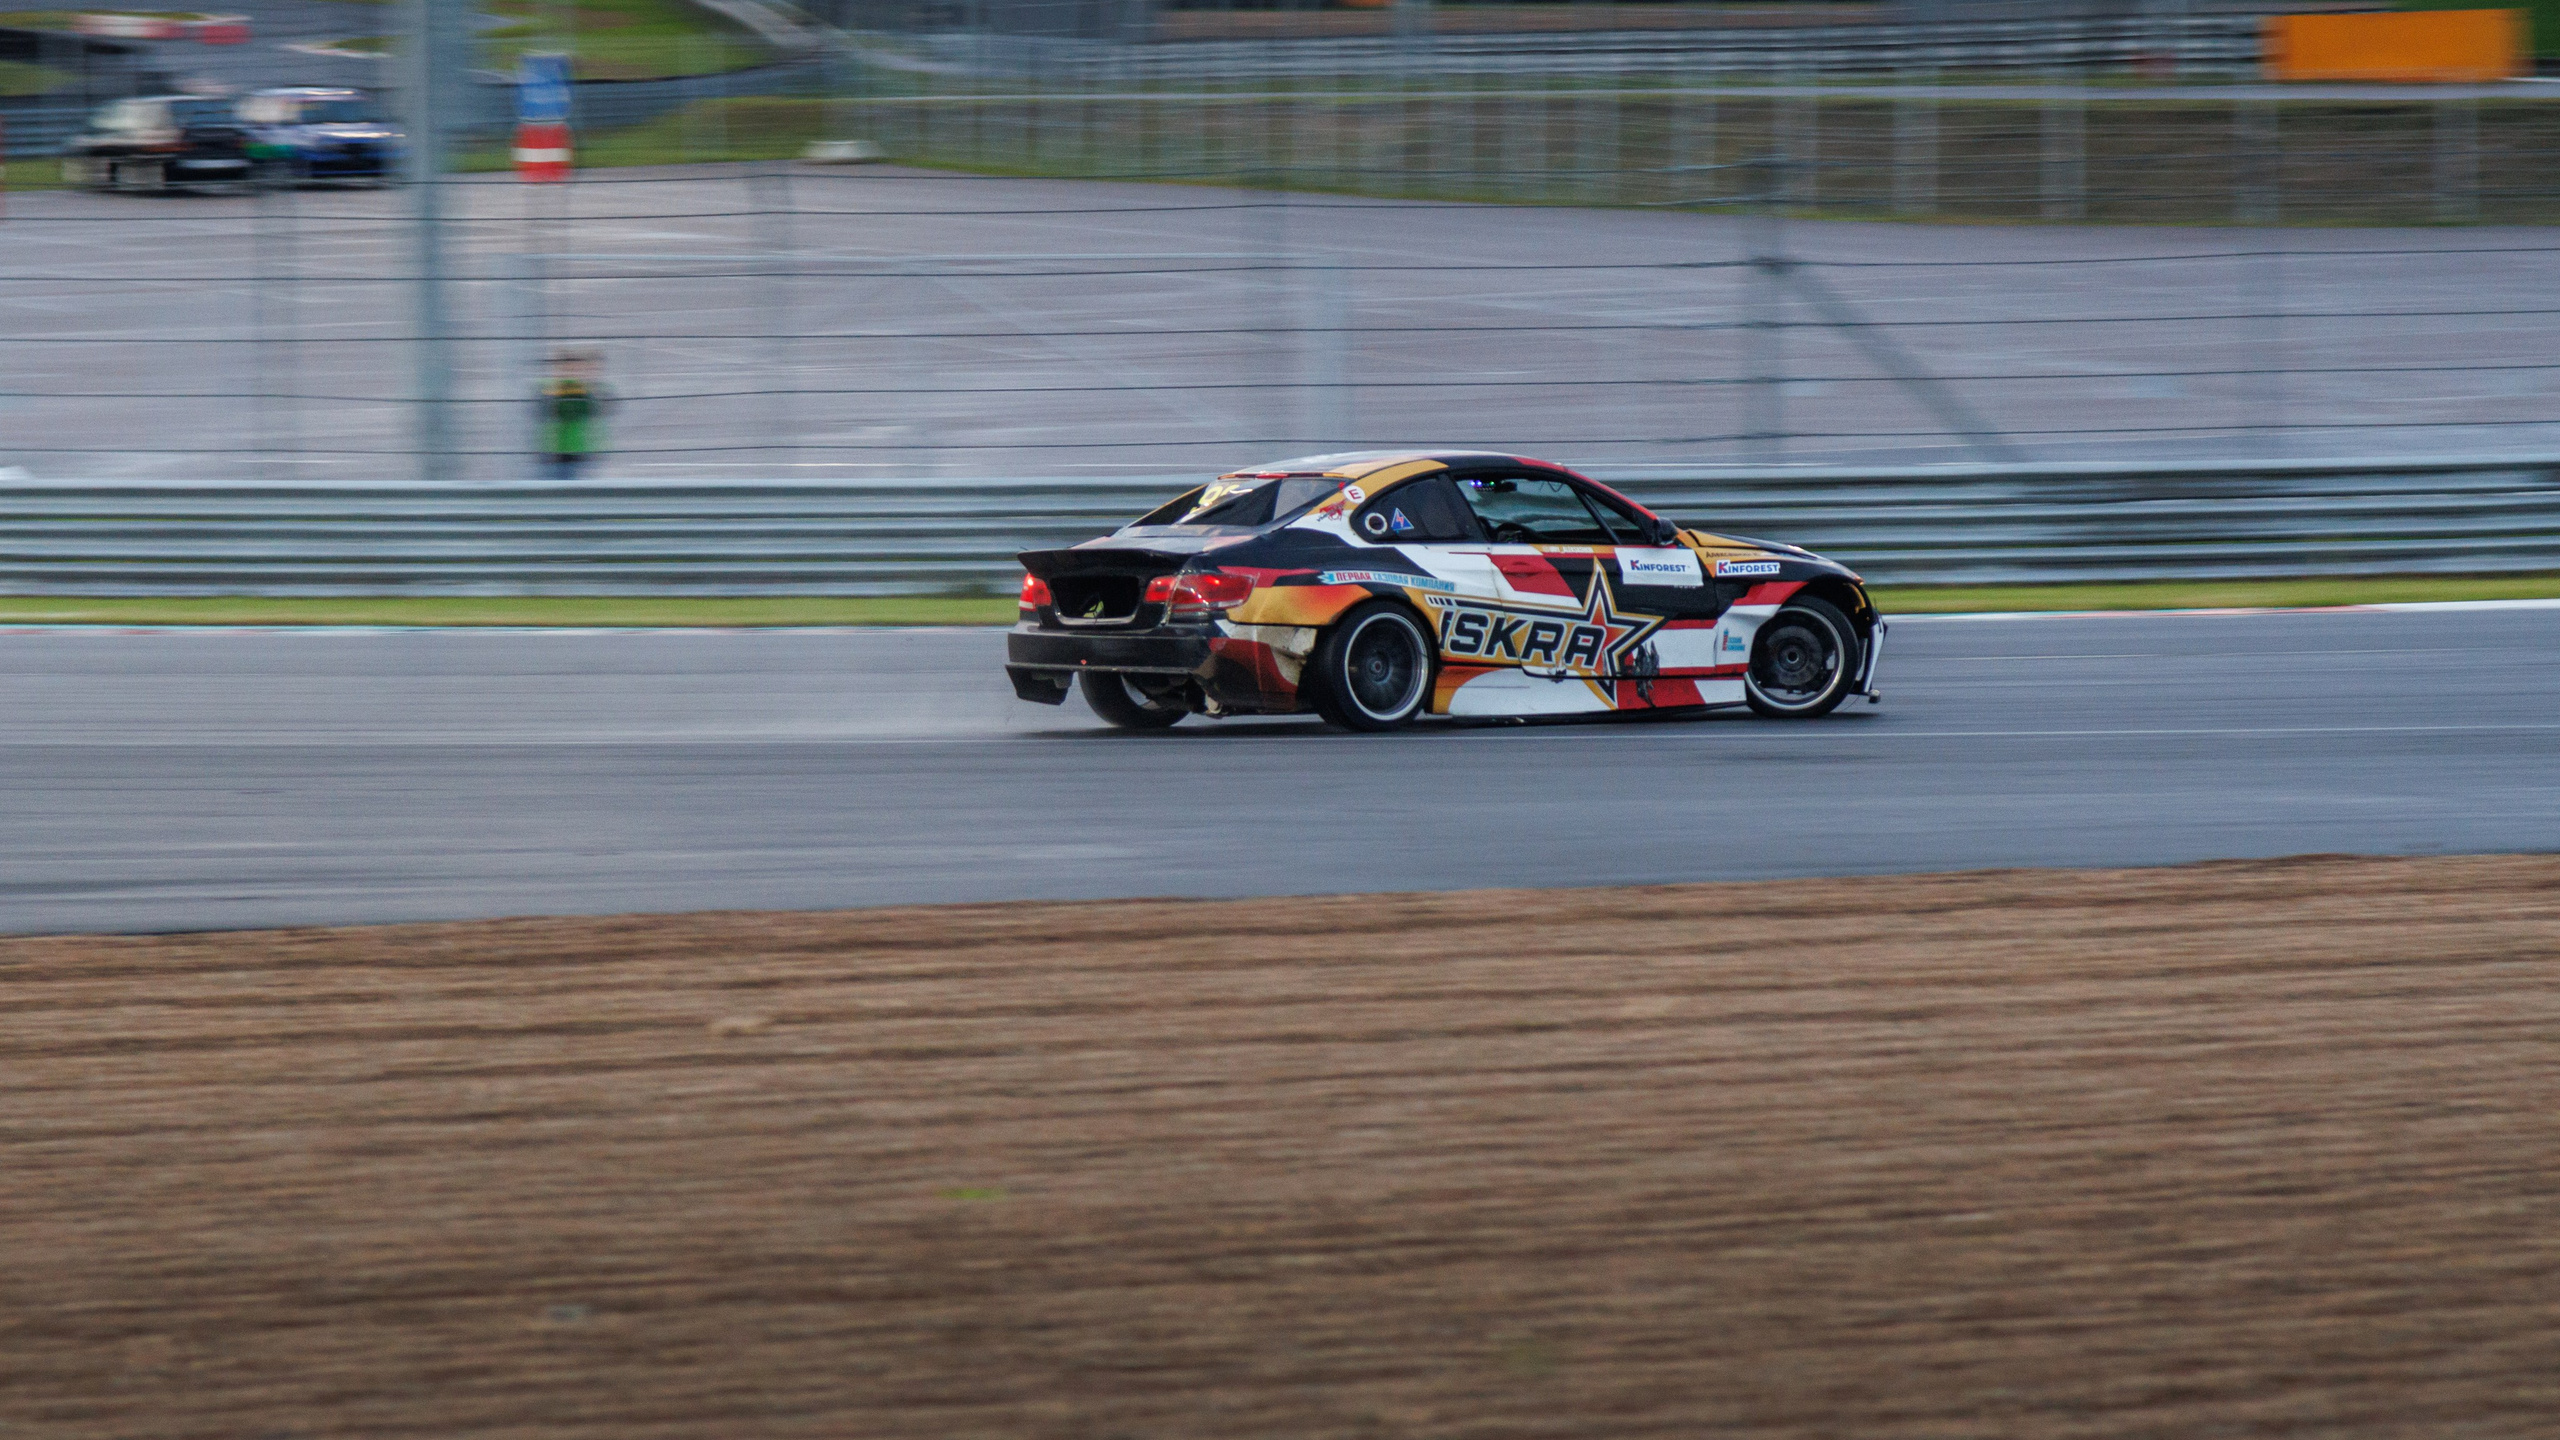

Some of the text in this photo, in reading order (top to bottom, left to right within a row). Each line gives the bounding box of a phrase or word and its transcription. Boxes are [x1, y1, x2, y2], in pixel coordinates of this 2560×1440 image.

[1348, 488, 1362, 500] E
[1630, 560, 1686, 572] KINFOREST
[1718, 561, 1778, 574] KINFOREST
[1336, 572, 1455, 592] ПЕРВАЯ ГАЗОВАЯ КОМПАНИЯ
[1440, 610, 1605, 668] ISKRA
